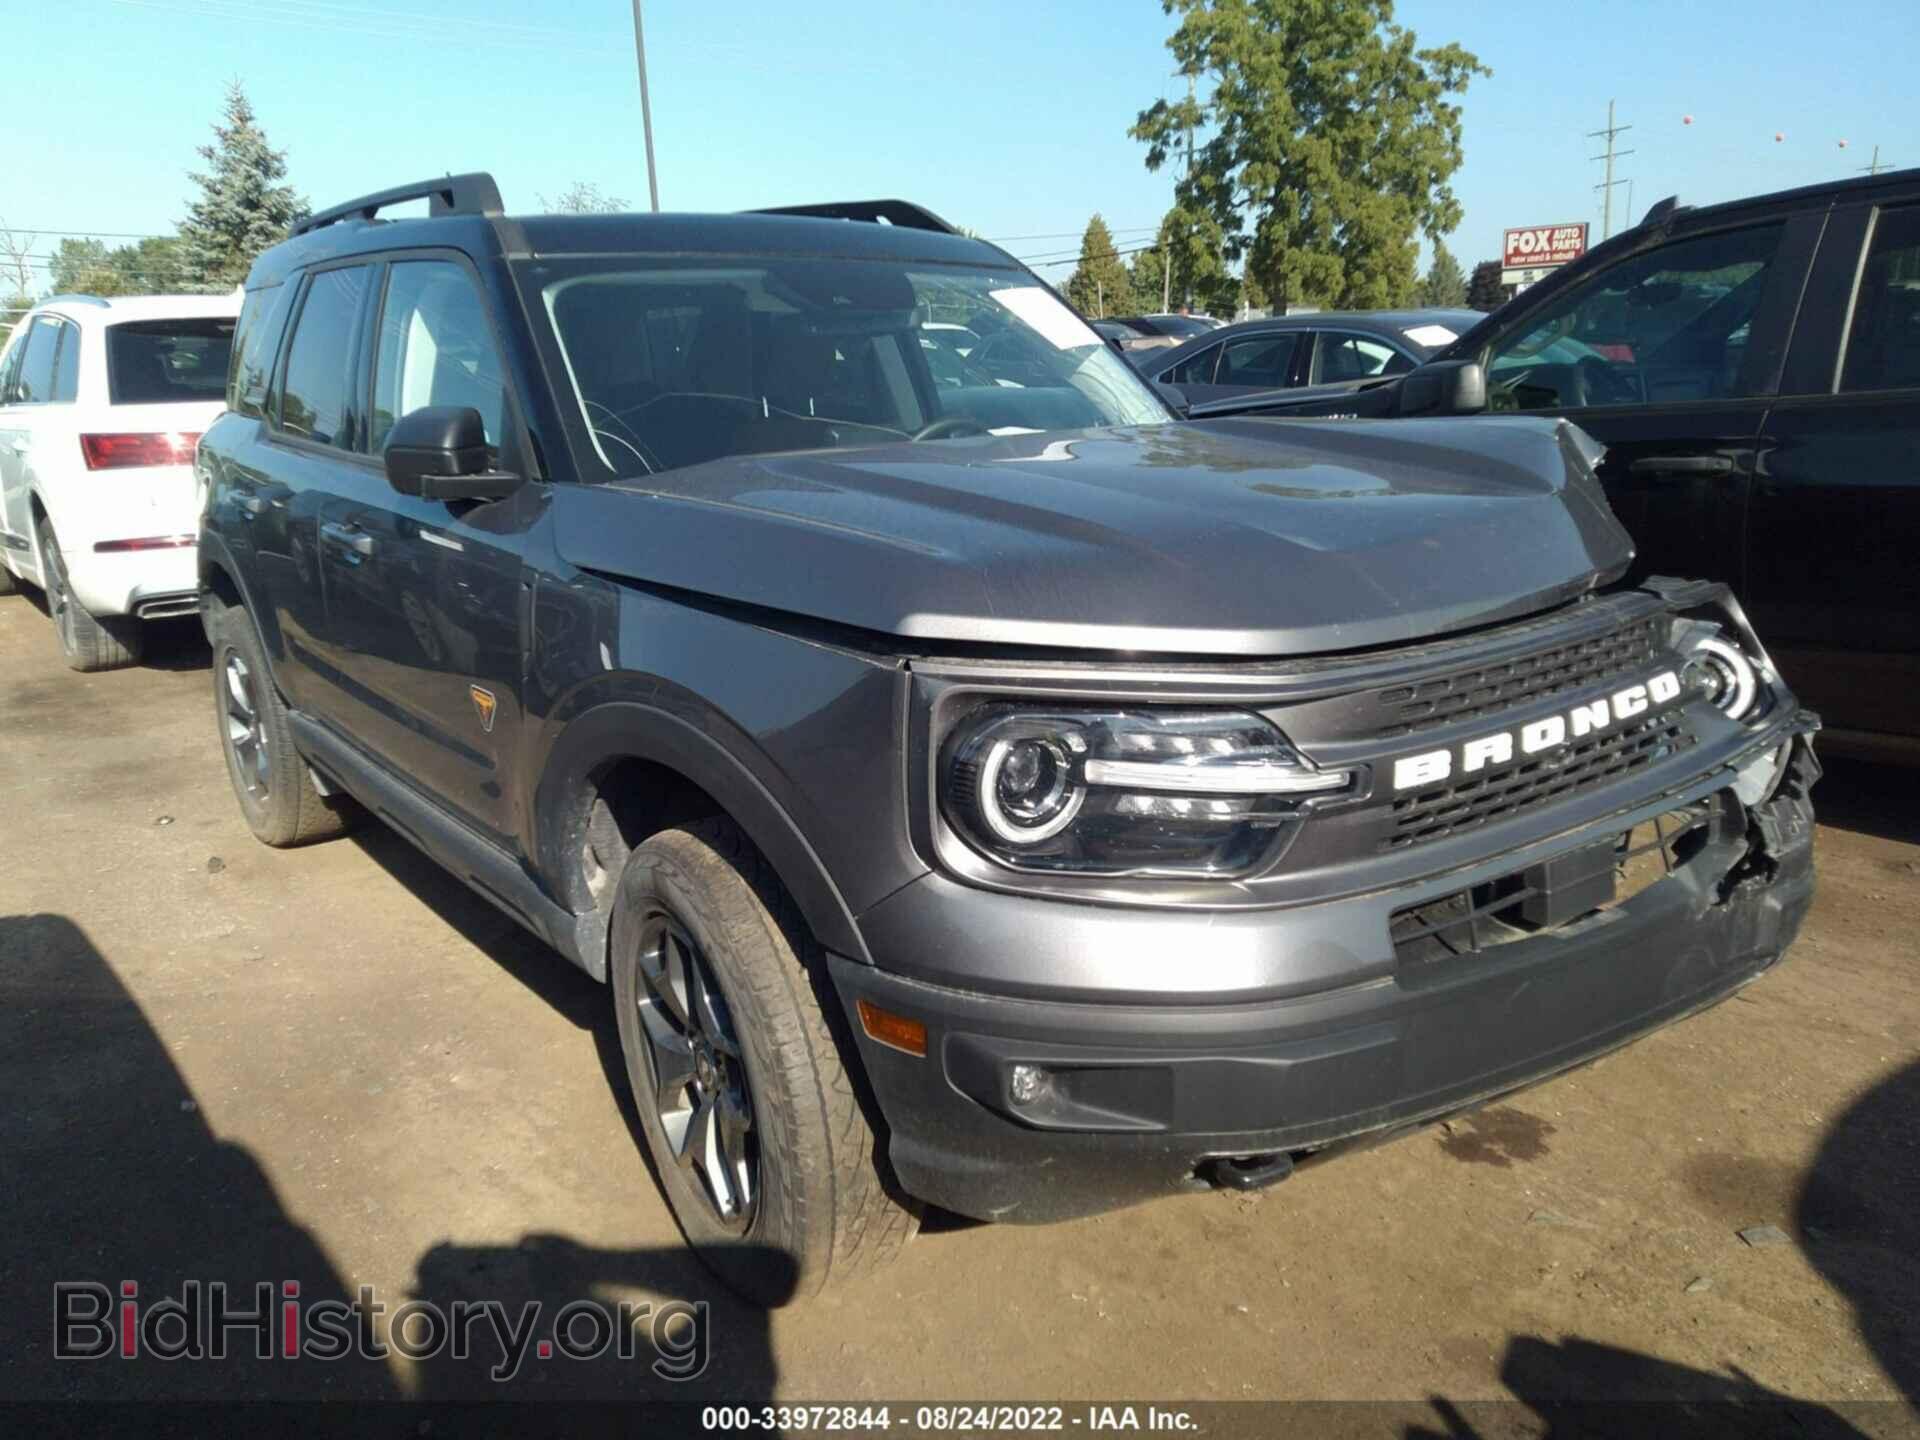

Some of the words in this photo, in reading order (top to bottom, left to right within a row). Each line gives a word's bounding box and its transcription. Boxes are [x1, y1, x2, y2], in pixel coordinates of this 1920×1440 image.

[1507, 229, 1551, 255] FOX
[1553, 227, 1580, 240] AUTO
[1552, 239, 1581, 251] PARTS
[1393, 671, 1681, 790] BRONCO
